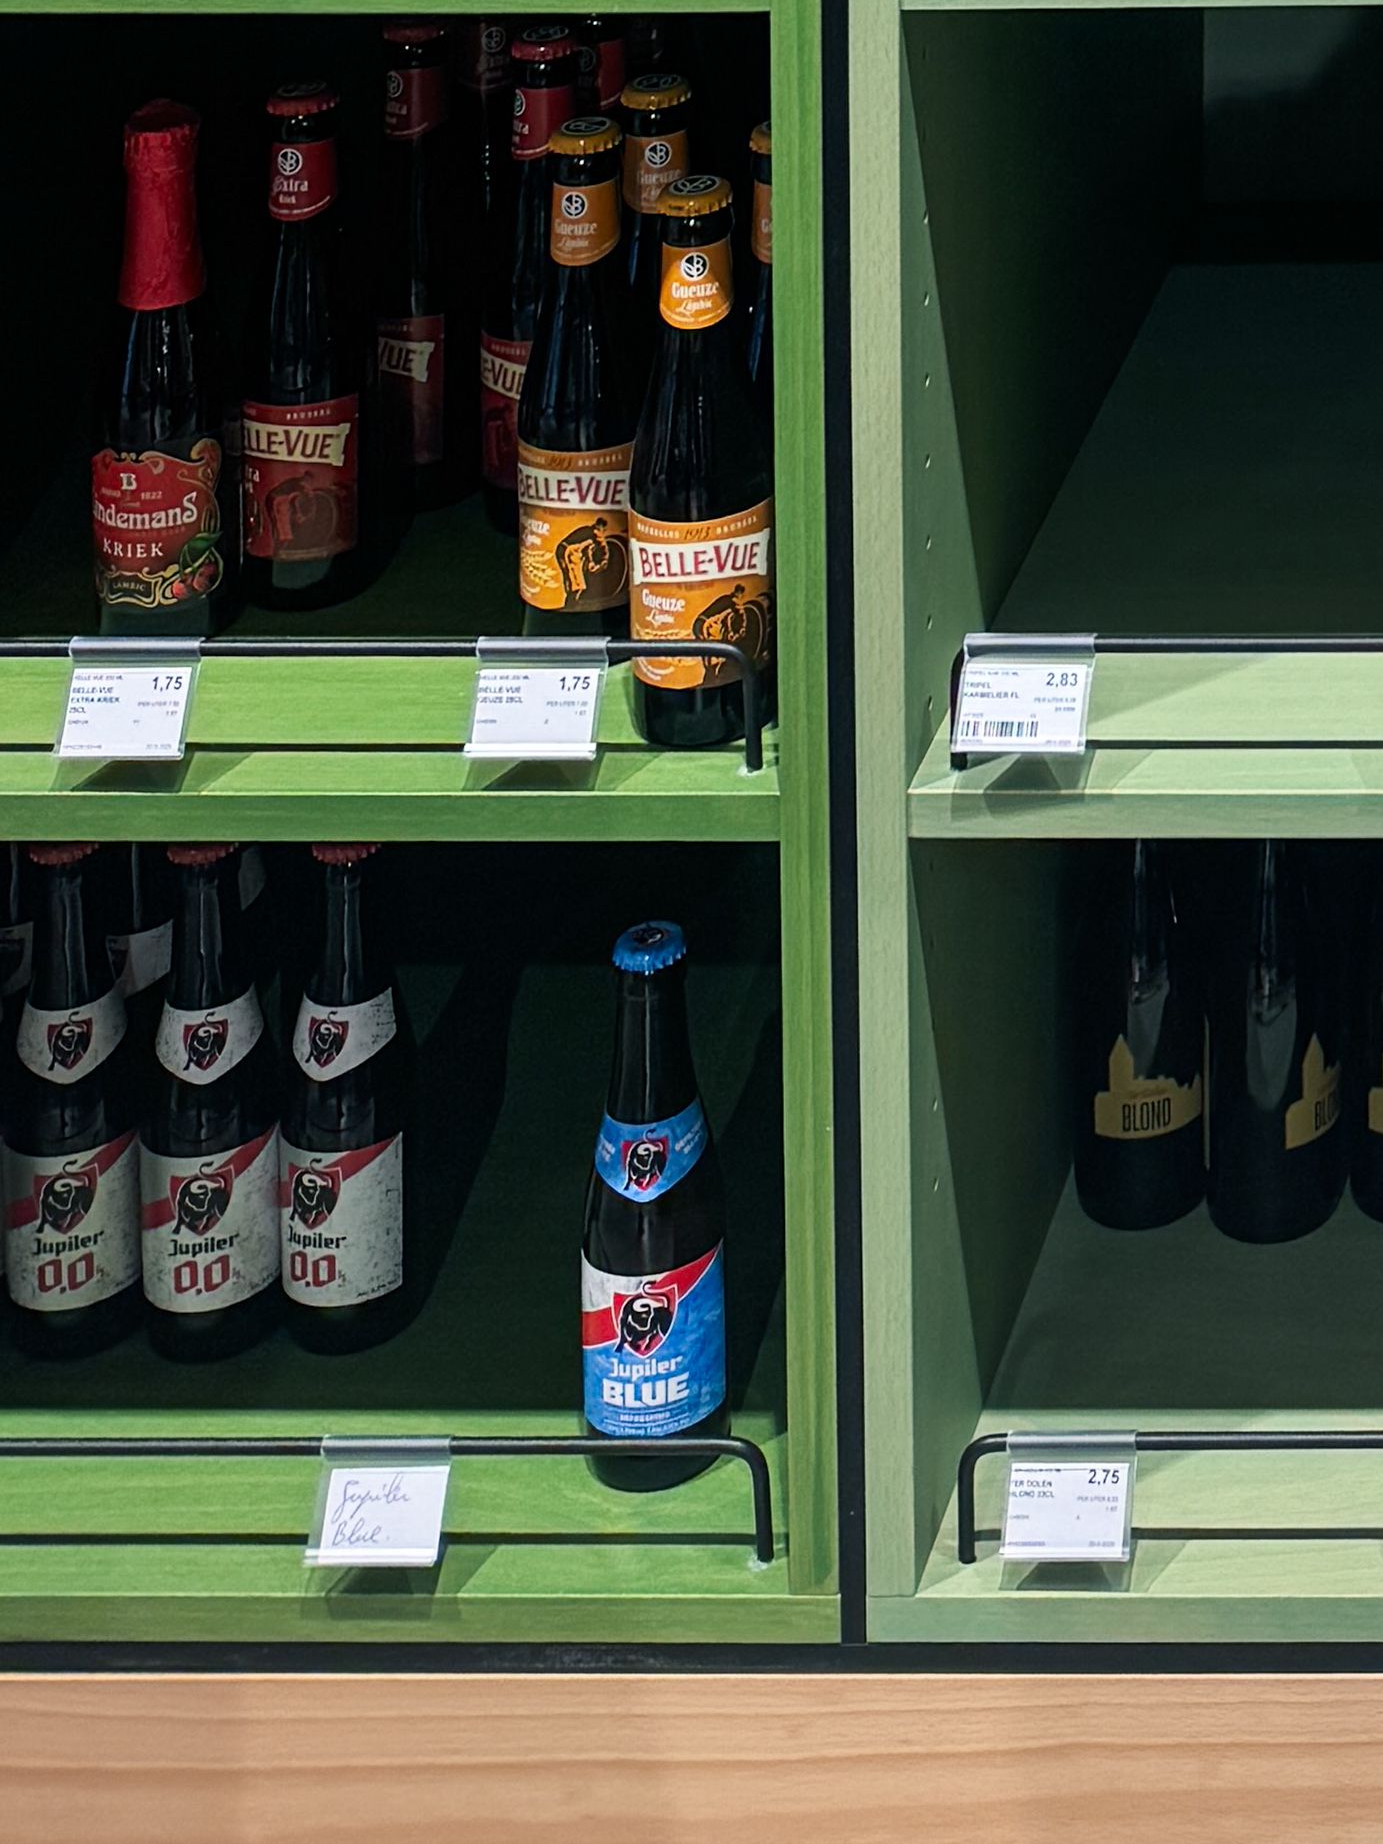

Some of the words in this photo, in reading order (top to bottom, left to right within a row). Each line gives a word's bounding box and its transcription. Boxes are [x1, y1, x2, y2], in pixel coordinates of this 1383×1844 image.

[671, 281, 720, 300] Gueuze
[102, 538, 165, 559] KRIEK
[640, 542, 764, 580] BELLE-VUE
[642, 589, 687, 614] Gueuze
[151, 676, 184, 692] 1,75
[558, 676, 592, 692] 1,75
[1046, 672, 1079, 687] 2,83
[1121, 1097, 1172, 1133] BLOND
[32, 1230, 105, 1258] Jupiler
[168, 1232, 240, 1258] Jupiler
[288, 1227, 347, 1251] Jupiler
[610, 1354, 684, 1378] Jupiler
[602, 1371, 690, 1408] BLUE
[1088, 1468, 1120, 1486] 2,75
